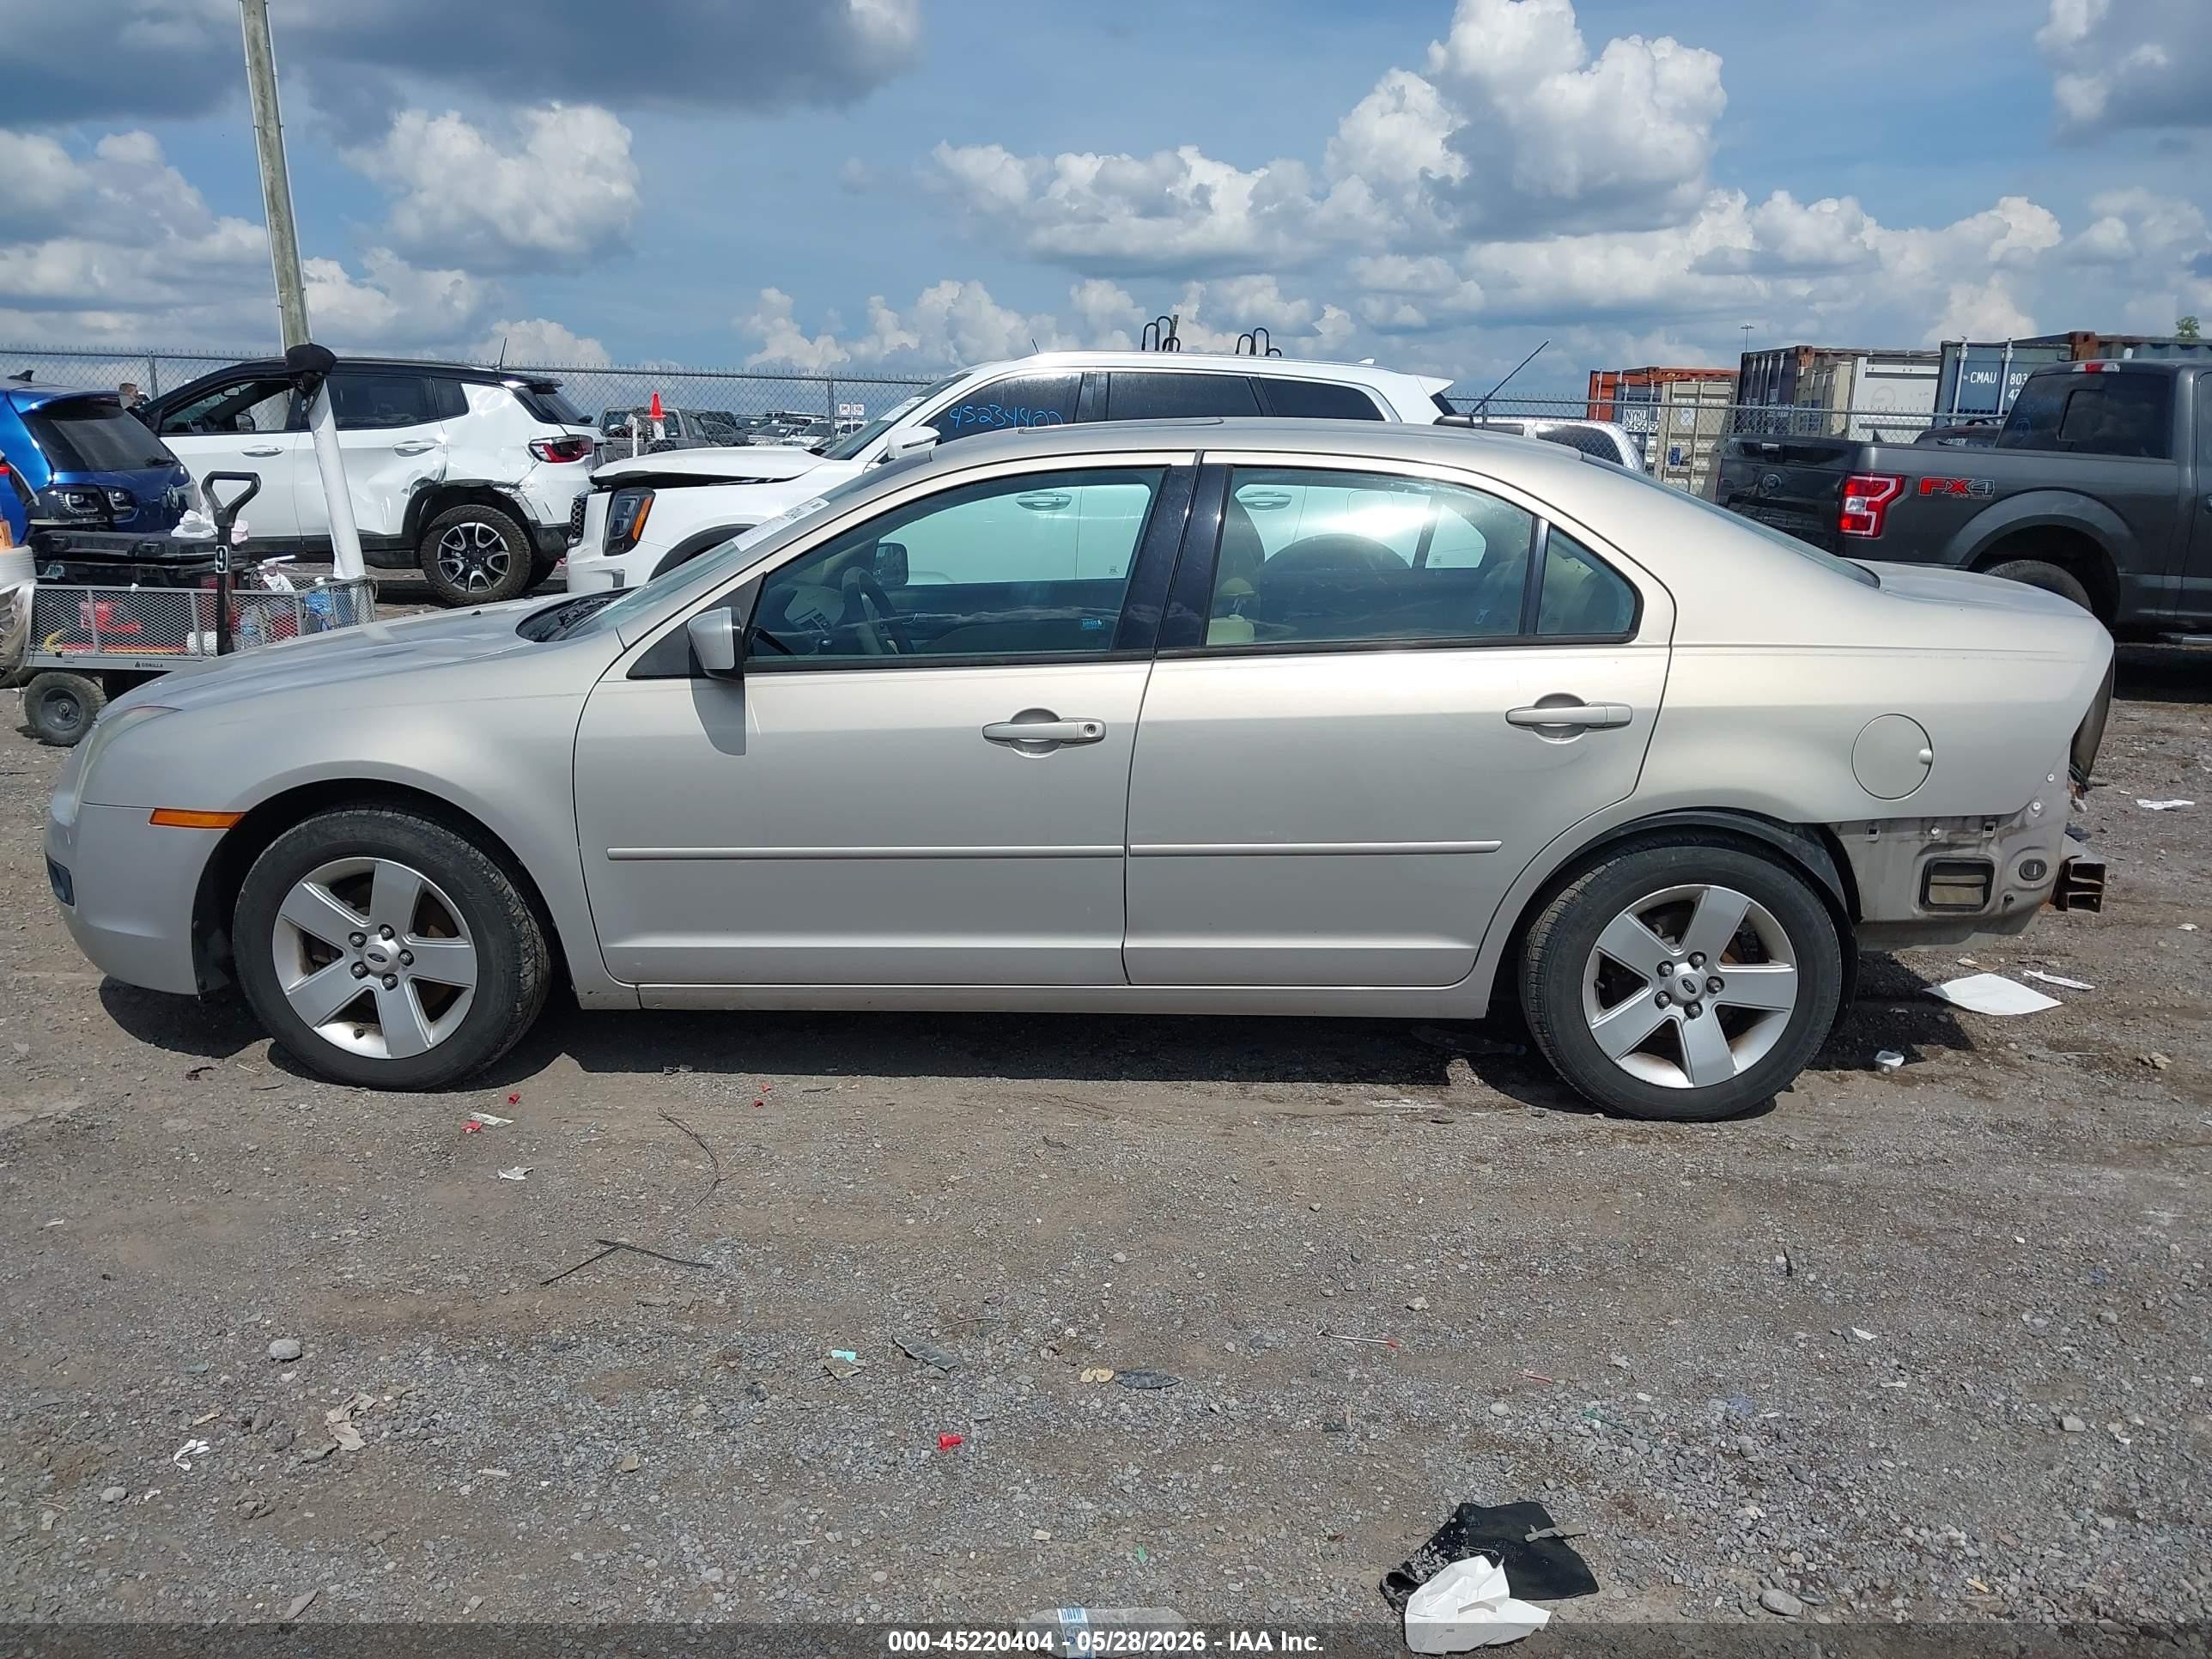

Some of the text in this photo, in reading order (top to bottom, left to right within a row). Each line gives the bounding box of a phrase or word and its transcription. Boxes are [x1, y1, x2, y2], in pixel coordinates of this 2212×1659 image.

[1970, 371, 1997, 384] CMAU
[1625, 410, 1648, 421] NYKU
[1919, 476, 1994, 496] FX4
[216, 546, 226, 572] 9
